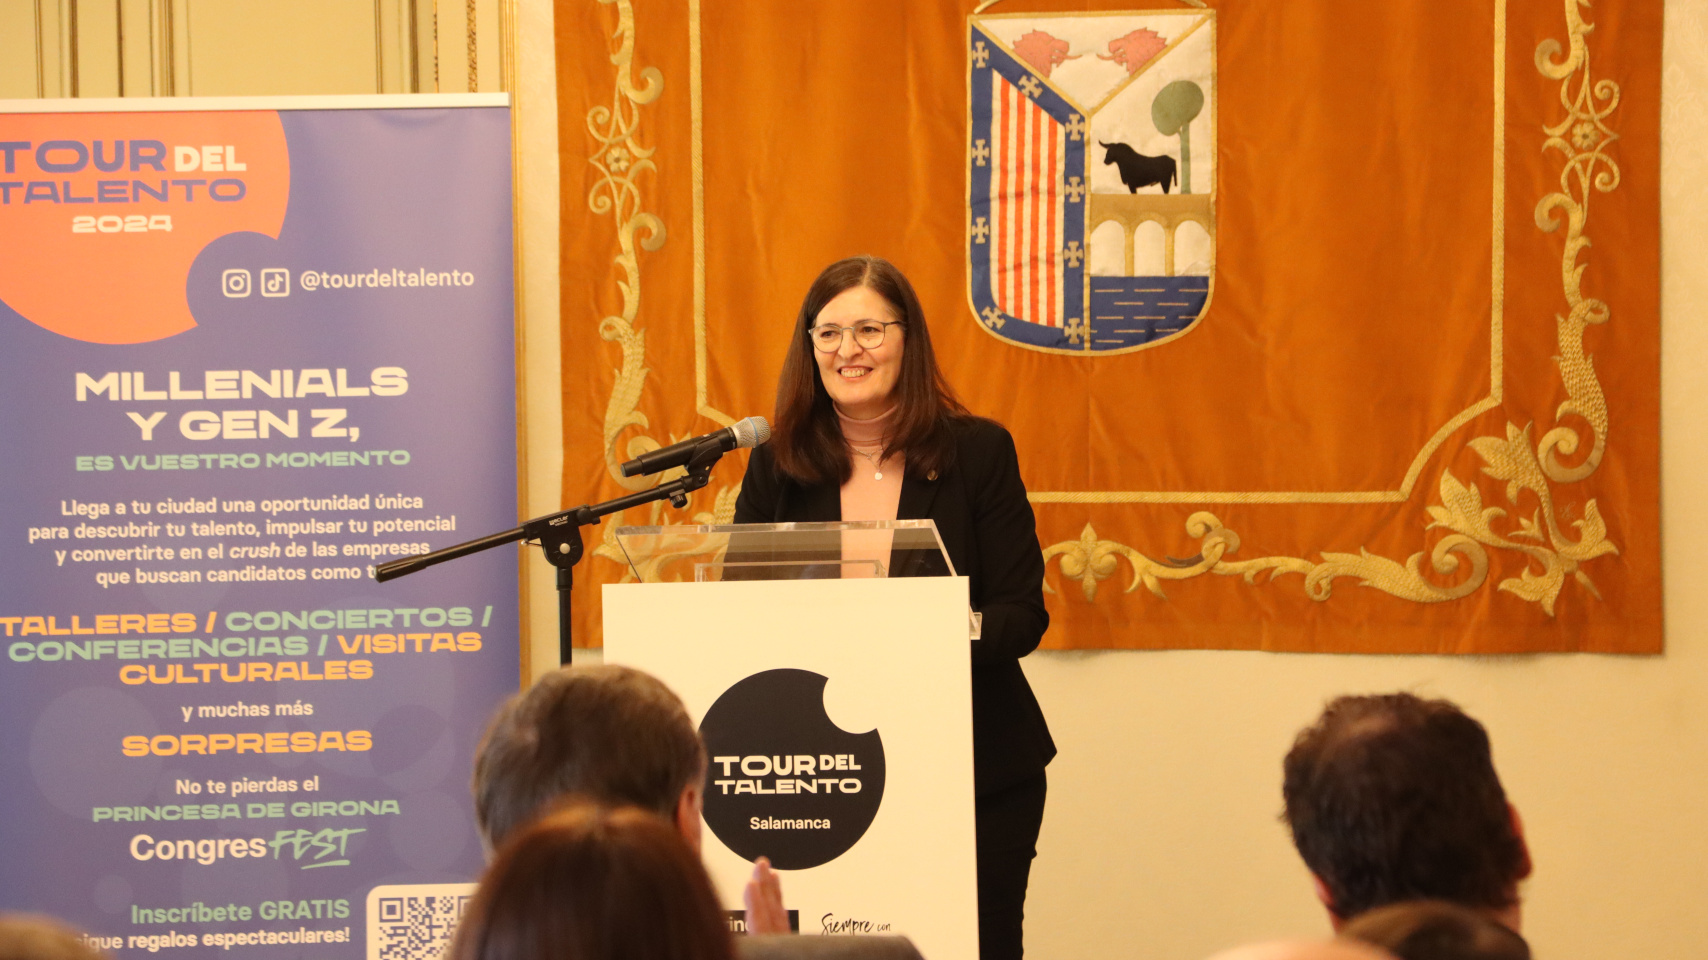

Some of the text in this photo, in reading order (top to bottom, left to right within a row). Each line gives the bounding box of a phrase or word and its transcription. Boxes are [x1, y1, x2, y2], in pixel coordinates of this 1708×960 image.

[0, 140, 247, 173] TOUR DEL
[0, 178, 247, 204] TALENTO
[72, 215, 173, 233] 2024
[301, 268, 474, 290] @tourdeltalento
[76, 367, 408, 401] MILLENIALS
[127, 409, 359, 442] Y GEN Z,
[76, 450, 410, 471] ES VUESTRO MOMENTO
[62, 494, 423, 519] Llega a tu ciudad una oportunidad única
[29, 515, 456, 543] para descubrir tu talento, impulsar tu potencial
[55, 542, 431, 566] y convertirte en el crush de las empresas
[95, 572, 131, 588] que
[136, 568, 201, 583] buscan
[207, 566, 306, 581] candidatos
[312, 568, 362, 579] como
[0, 613, 197, 636] TALLERES
[225, 606, 474, 632] CONCIERTOS
[8, 637, 309, 662] CONFERENCIAS
[337, 632, 482, 654] VISITAS
[119, 660, 374, 685] CULTURALES
[182, 700, 314, 722] y muchas más
[122, 730, 373, 757] SORPRESAS
[714, 754, 861, 776] TOUR DEL
[176, 776, 319, 797] No te pierdas el
[714, 778, 862, 795] TALENTO
[94, 800, 400, 822] PRINCESA DE GIRONA
[750, 816, 831, 830] Salamanca
[132, 899, 350, 923] Inscríbete GRATIS
[821, 912, 892, 935] Siempre con
[128, 931, 198, 952] regalos
[202, 927, 350, 949] espectaculares!
